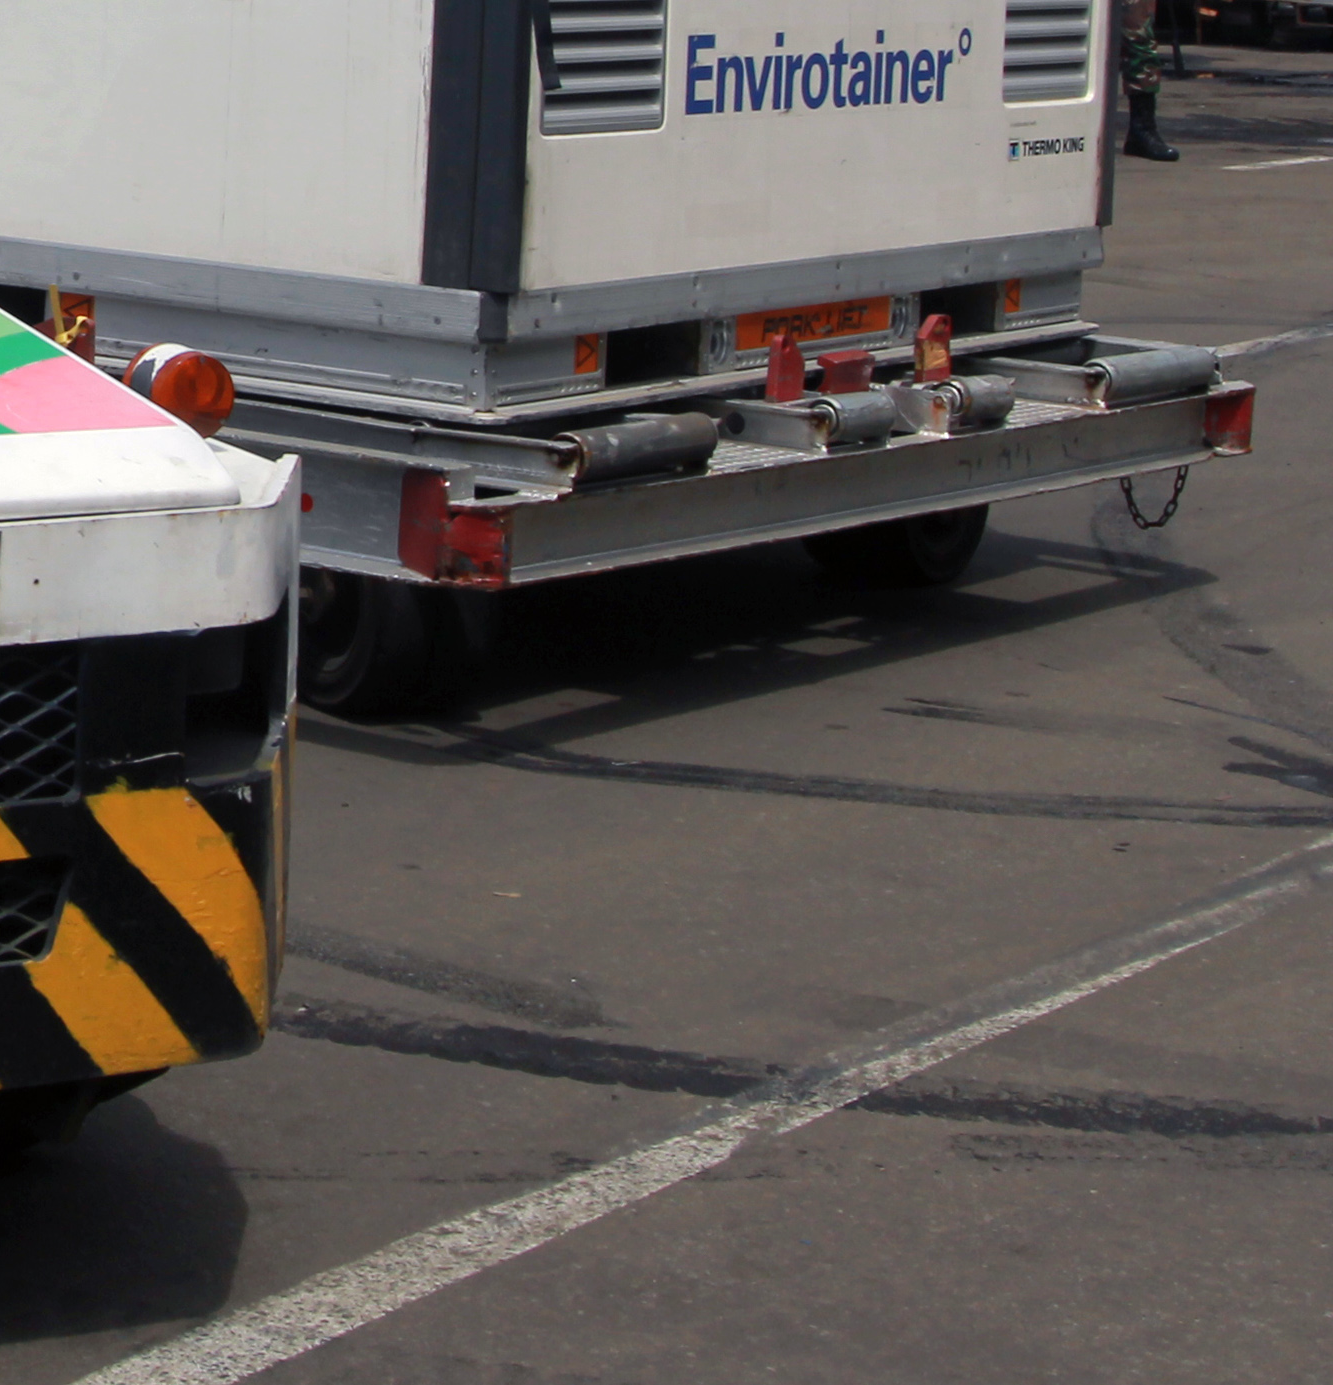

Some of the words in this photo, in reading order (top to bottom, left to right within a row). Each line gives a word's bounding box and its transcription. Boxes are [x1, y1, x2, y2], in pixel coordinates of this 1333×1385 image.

[685, 30, 954, 115] Envirotainer
[1022, 138, 1062, 157] THERMO
[1063, 136, 1085, 153] KING
